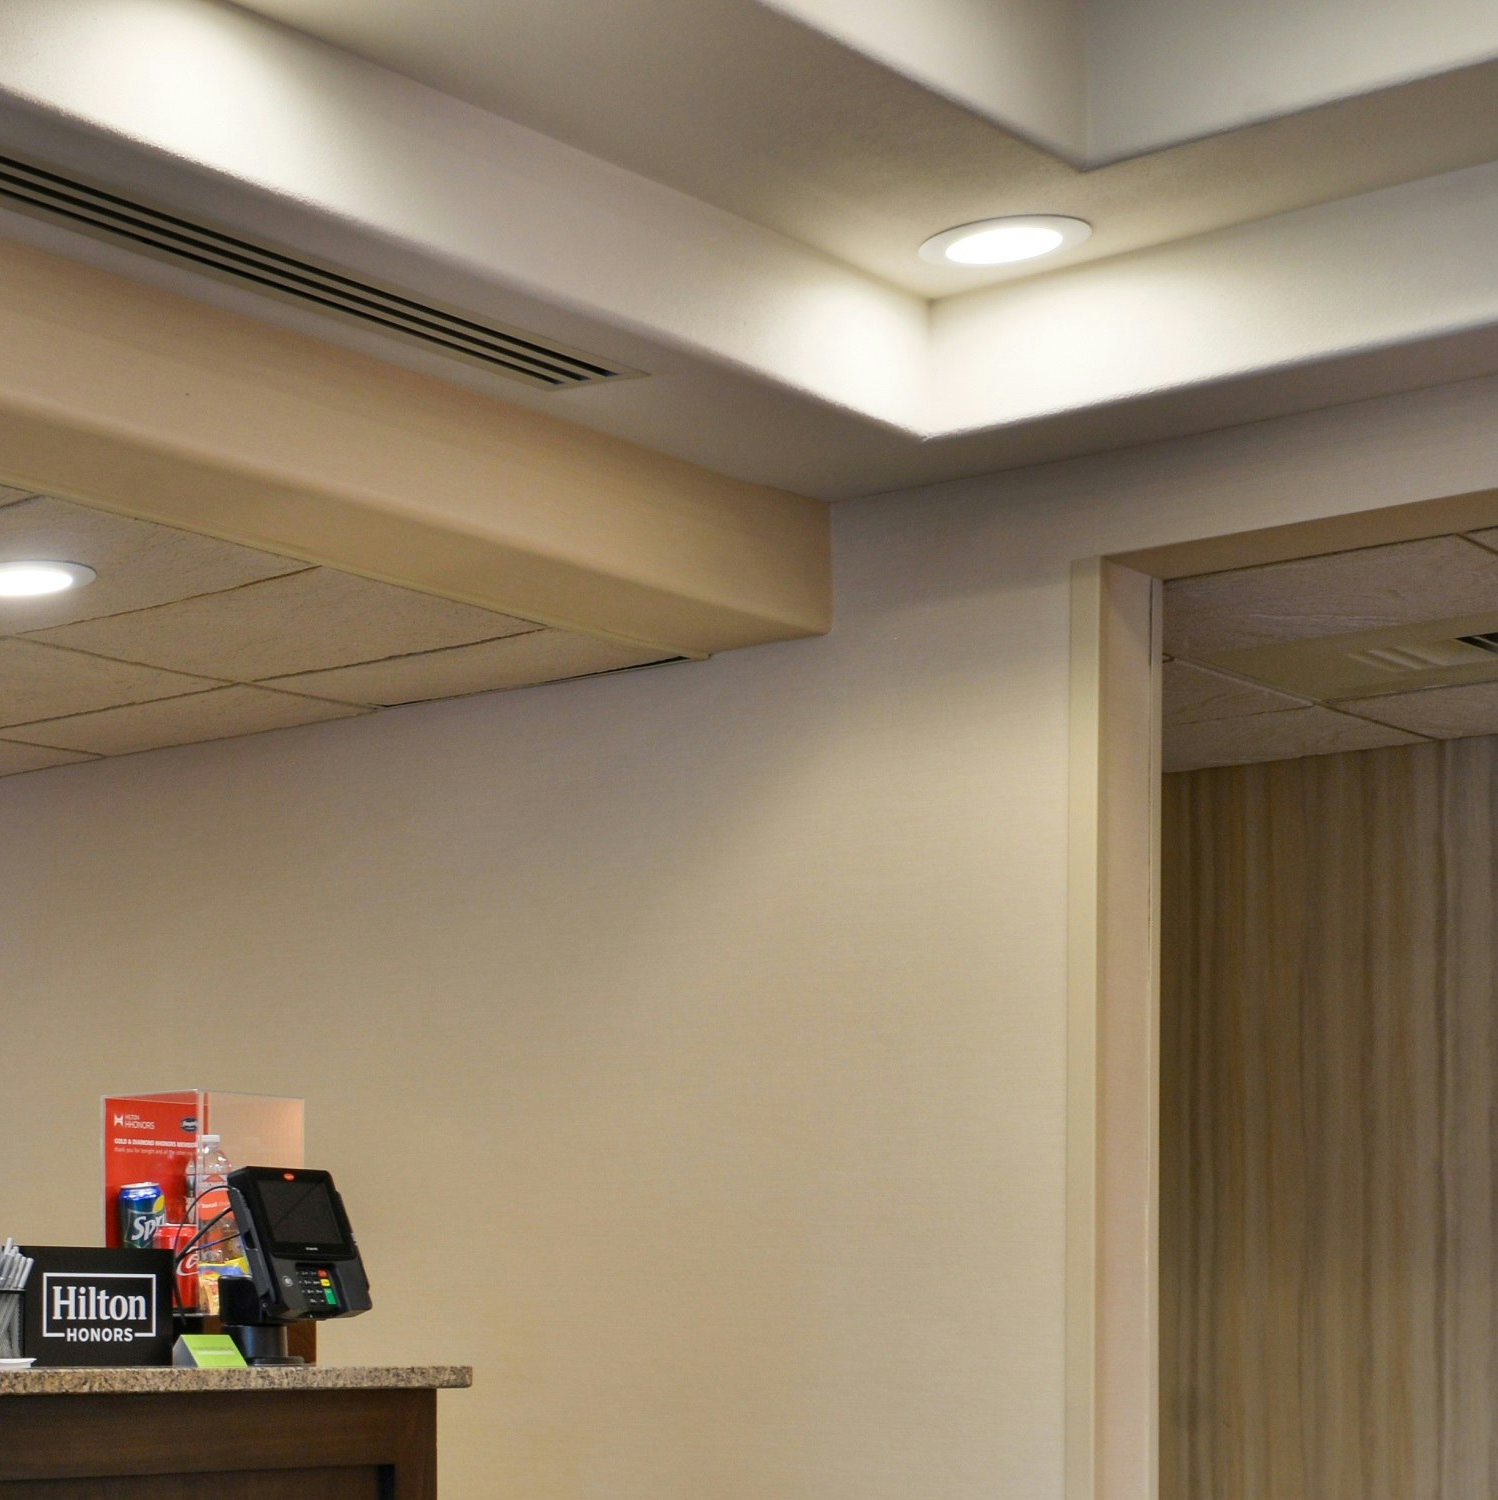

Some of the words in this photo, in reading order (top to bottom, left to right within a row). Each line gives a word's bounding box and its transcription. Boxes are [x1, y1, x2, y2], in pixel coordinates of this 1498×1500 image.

[124, 1121, 155, 1130] HHONORS
[52, 1286, 147, 1320] Hilton
[66, 1327, 134, 1342] HONORS
